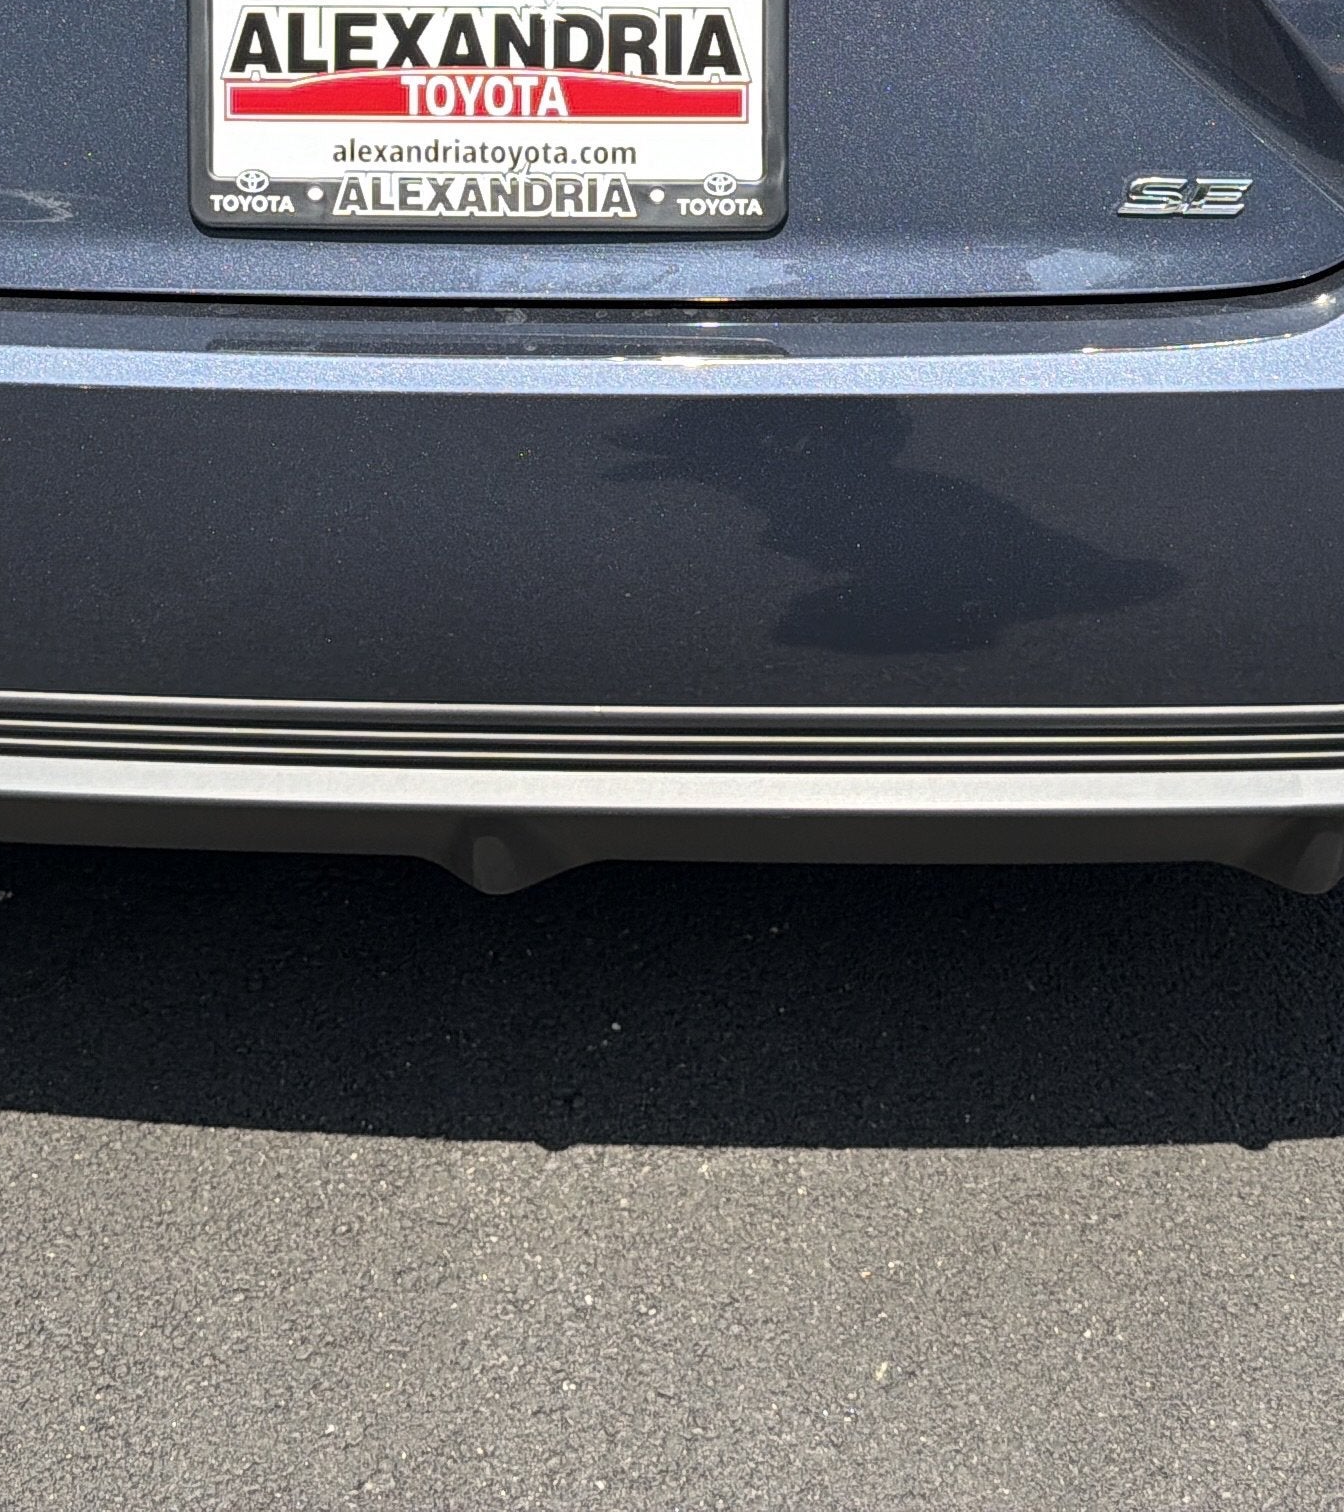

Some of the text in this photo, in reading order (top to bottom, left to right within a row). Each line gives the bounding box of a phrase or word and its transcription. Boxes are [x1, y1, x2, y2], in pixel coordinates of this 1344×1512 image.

[229, 12, 743, 77] ALEXANDRIA
[401, 74, 569, 117] TOYOTA
[332, 138, 637, 171] alexandriatoyota.com
[210, 173, 763, 217] TOYOTA ALEXANDRIA TOYOTA
[1117, 176, 1253, 218] SE
